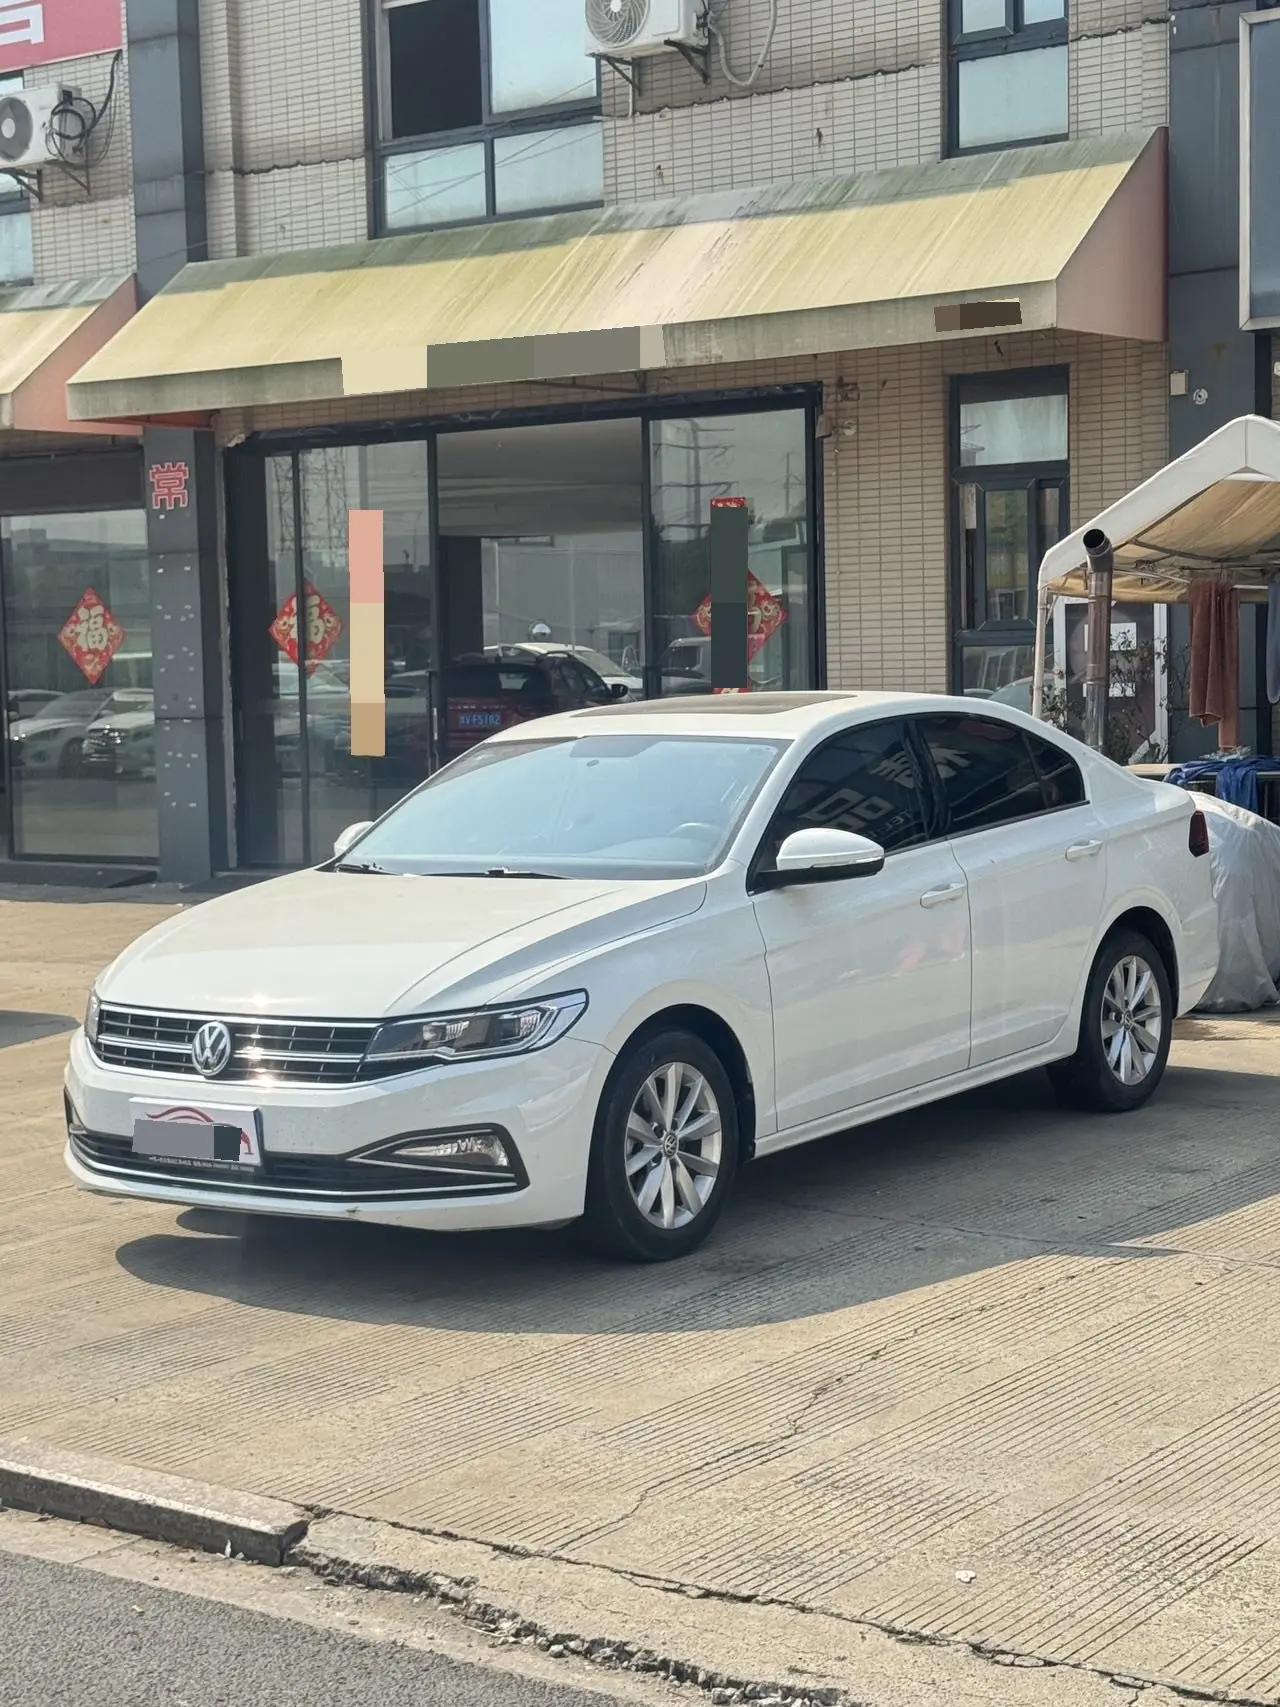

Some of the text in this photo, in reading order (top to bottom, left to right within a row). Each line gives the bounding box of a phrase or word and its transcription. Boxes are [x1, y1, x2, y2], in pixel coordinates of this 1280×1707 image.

[149, 462, 189, 510] 常
[76, 605, 108, 650] 福
[194, 1023, 230, 1074] VW
